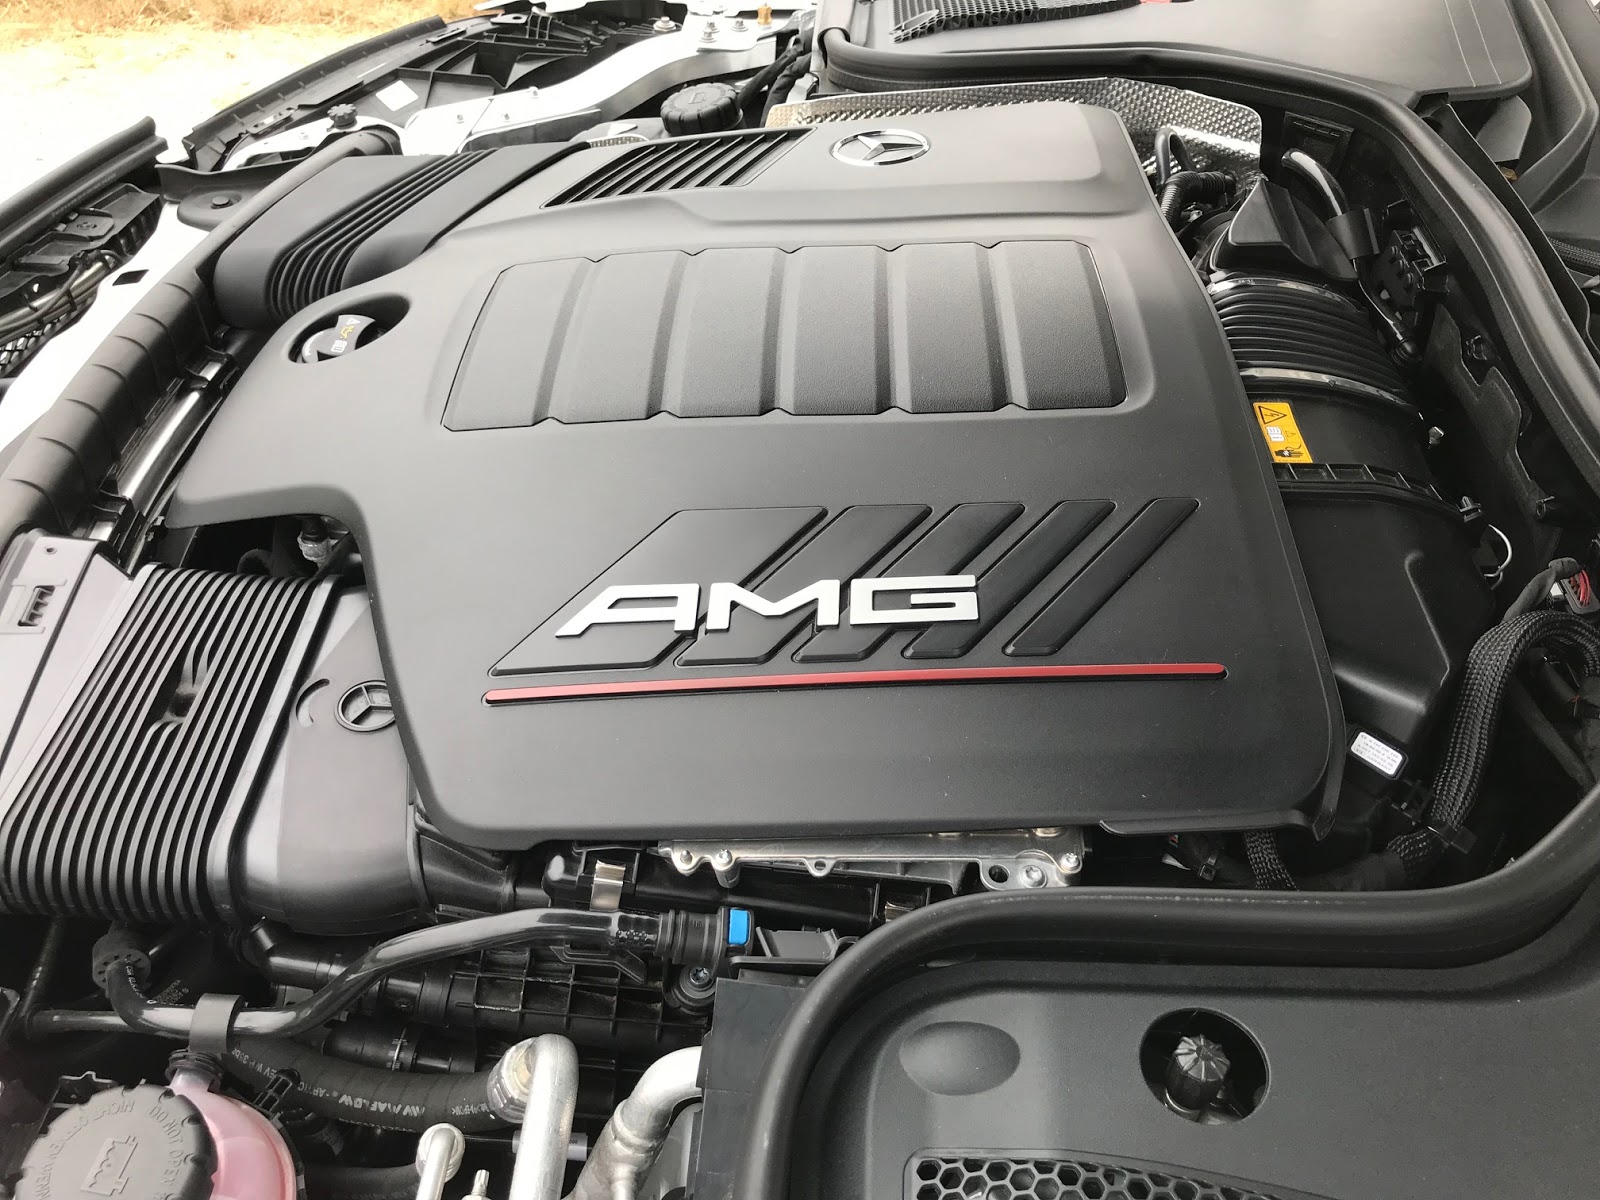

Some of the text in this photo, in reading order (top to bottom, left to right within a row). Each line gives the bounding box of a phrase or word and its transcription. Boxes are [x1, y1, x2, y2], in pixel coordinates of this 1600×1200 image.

[555, 575, 979, 637] AMG
[150, 1105, 168, 1123] DO
[163, 1118, 183, 1144] NOT
